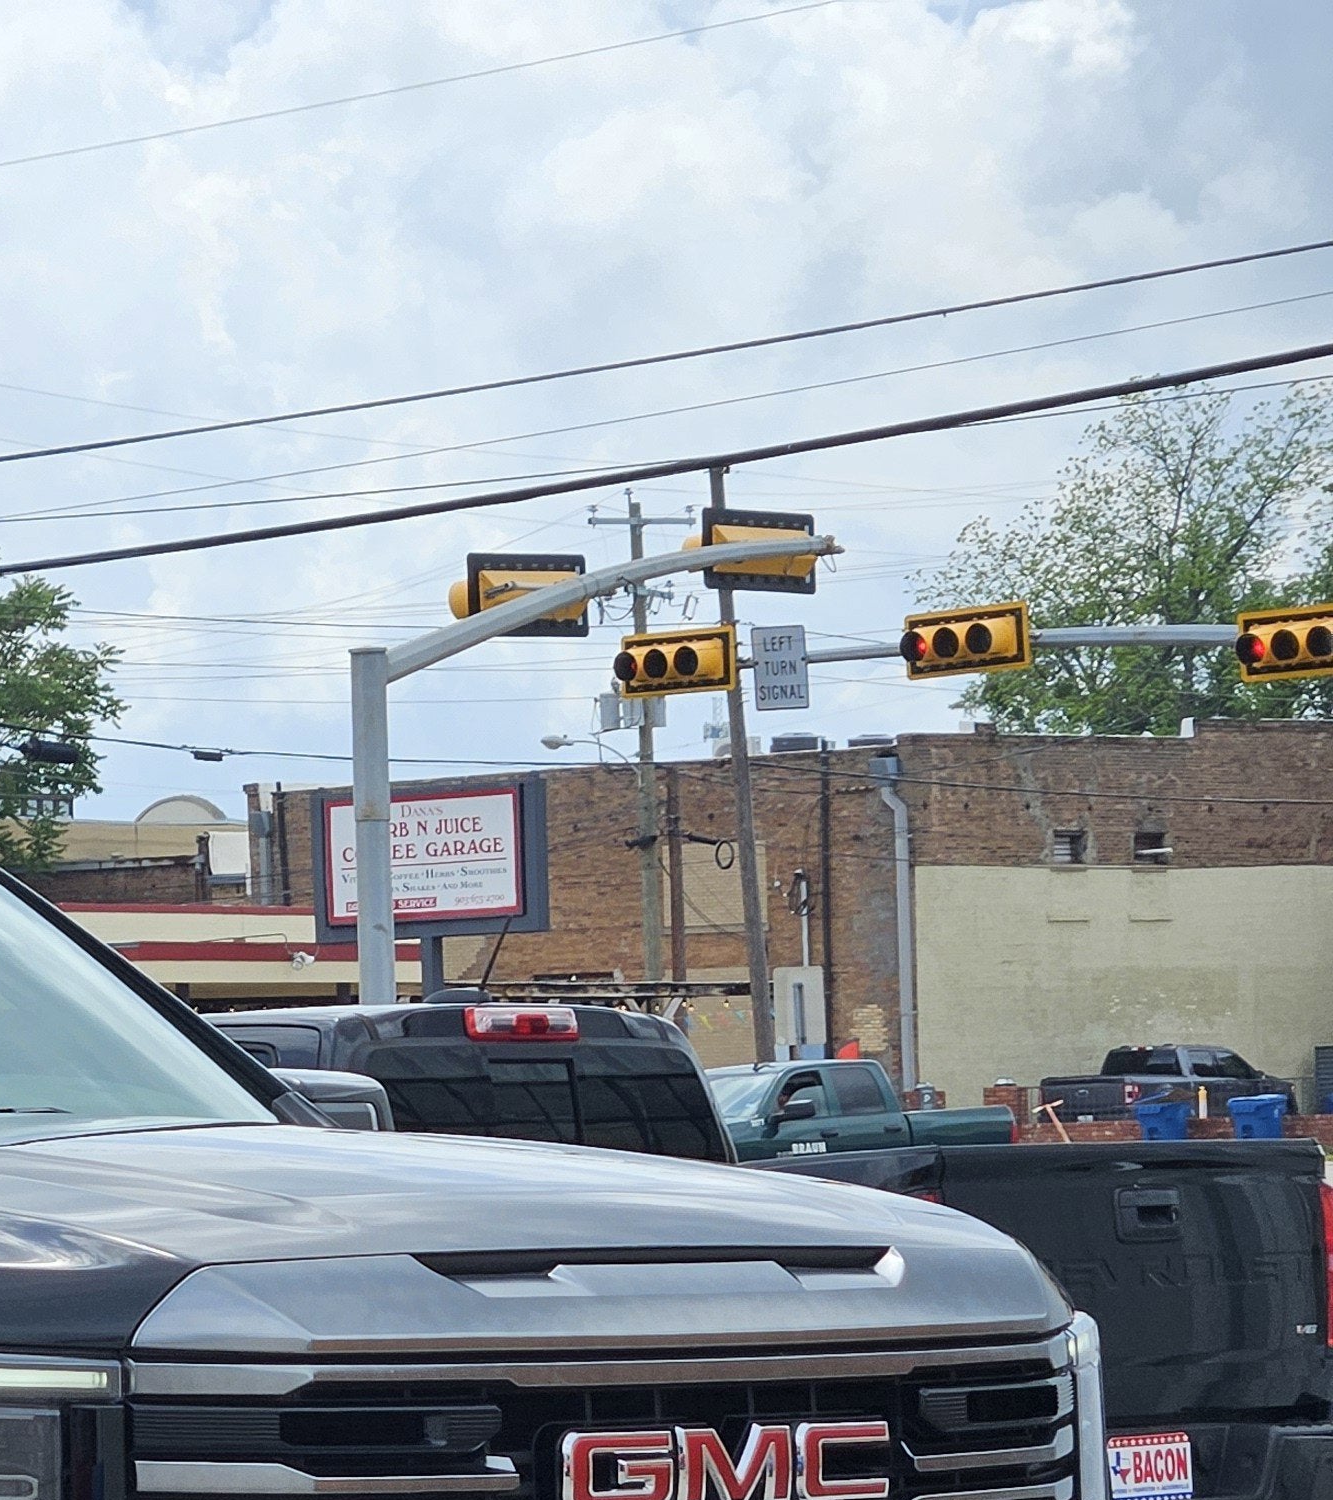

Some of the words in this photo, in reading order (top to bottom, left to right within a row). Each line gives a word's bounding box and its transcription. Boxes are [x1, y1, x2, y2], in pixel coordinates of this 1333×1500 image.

[763, 635, 793, 652] LEFT
[764, 660, 797, 676] TURN
[759, 684, 805, 701] SIGNAL
[390, 821, 409, 838] RB
[417, 820, 428, 836] N
[435, 816, 483, 835] JUICE
[342, 843, 418, 863] CEE
[425, 837, 505, 858] GARAGE
[397, 898, 436, 909] SERVICE
[1133, 1447, 1188, 1484] BACON
